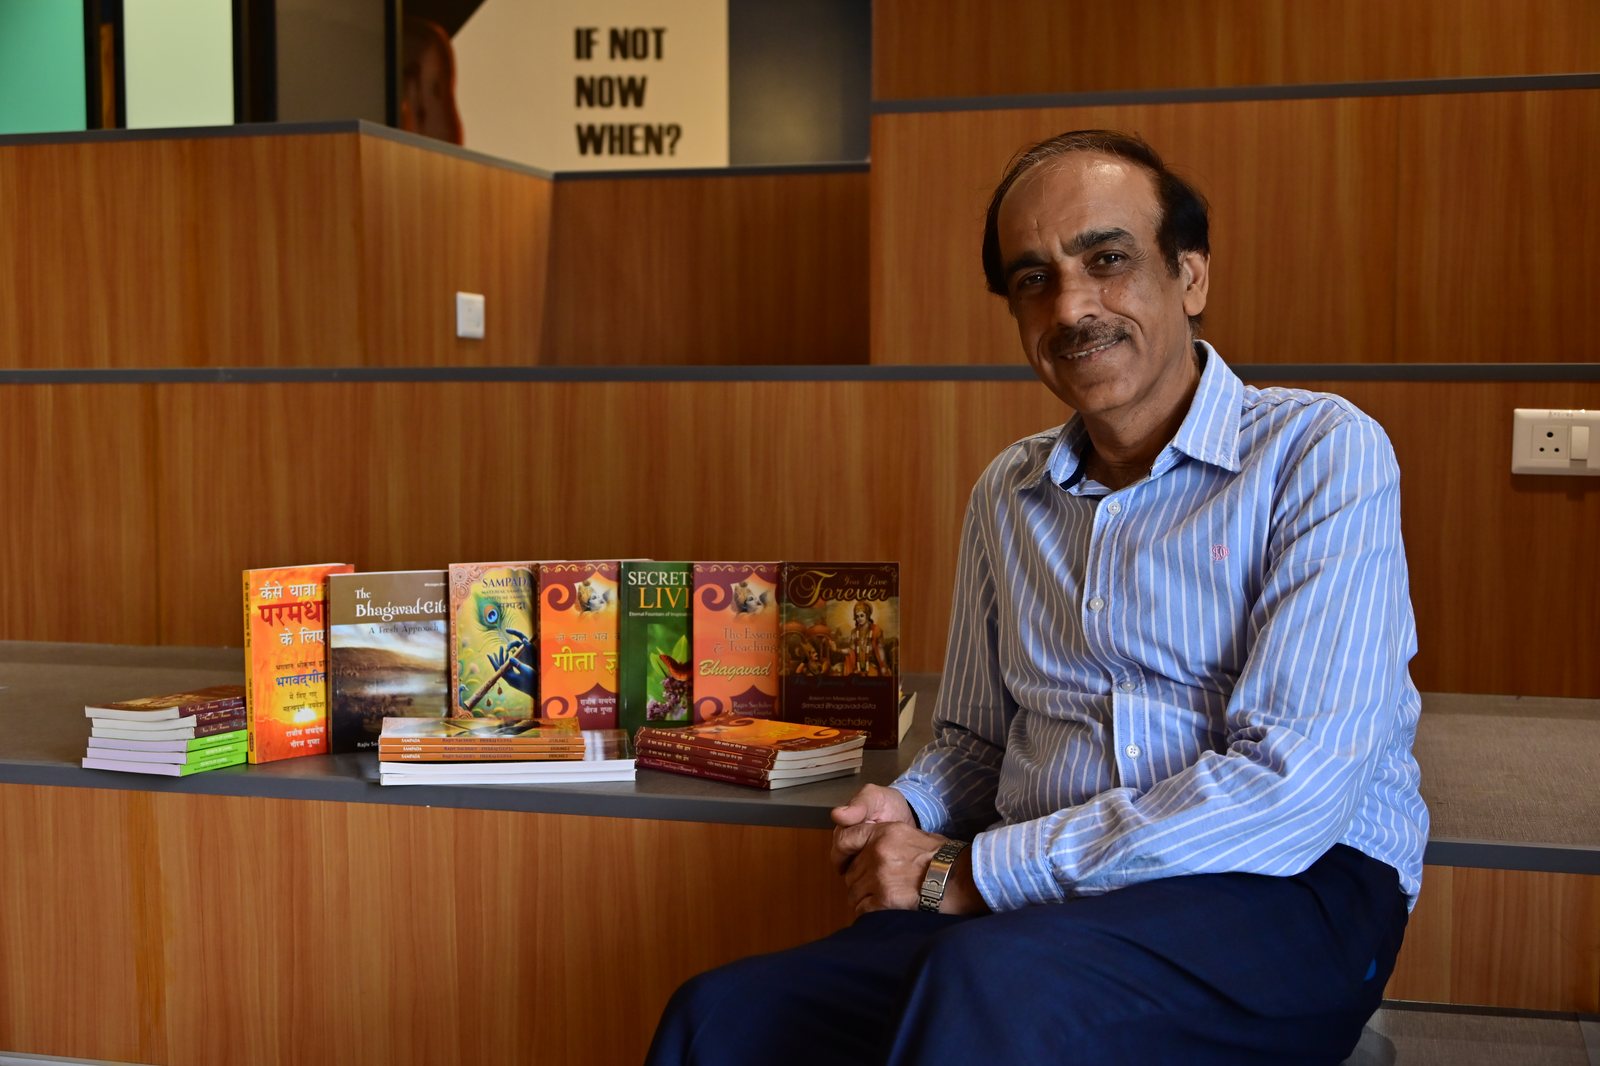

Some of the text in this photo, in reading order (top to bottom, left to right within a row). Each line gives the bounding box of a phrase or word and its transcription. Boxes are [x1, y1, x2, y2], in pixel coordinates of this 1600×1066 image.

[575, 27, 667, 60] IF NOT
[576, 76, 647, 108] NOW
[576, 124, 682, 156] WHEN?
[259, 581, 317, 599] कैसे यात्रा
[355, 587, 371, 599] The
[788, 570, 888, 607] Forever
[279, 627, 325, 645] के लिए
[724, 627, 742, 639] The
[552, 645, 597, 672] गीता
[699, 659, 772, 681] Bhagavad
